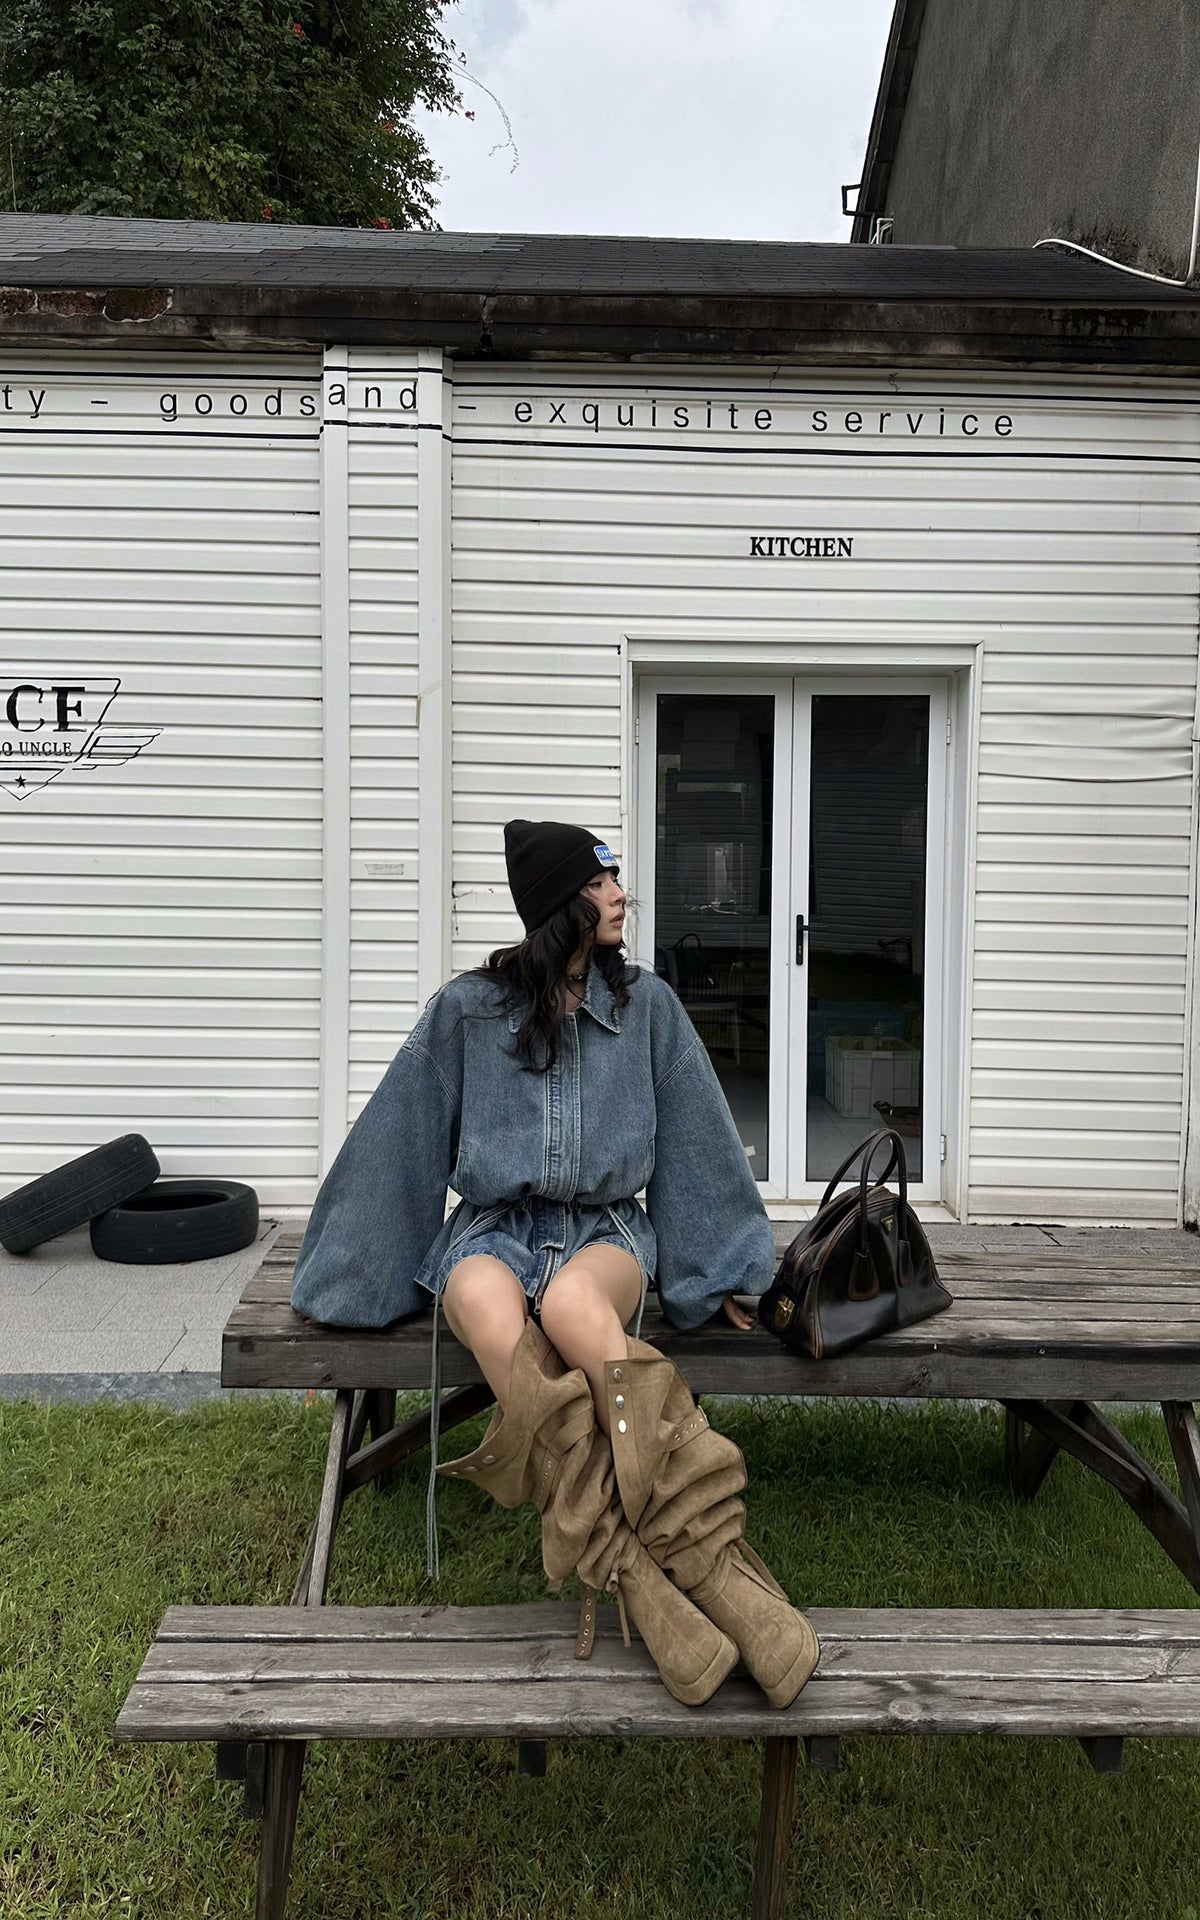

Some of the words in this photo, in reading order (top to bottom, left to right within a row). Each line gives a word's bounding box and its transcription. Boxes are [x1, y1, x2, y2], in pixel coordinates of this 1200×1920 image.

[2, 384, 46, 419] ty
[159, 387, 317, 422] goods
[328, 381, 418, 411] and
[514, 399, 773, 433] exquisite
[811, 407, 1014, 437] service
[749, 536, 854, 557] KITCHEN
[18, 741, 73, 757] UNCLE
